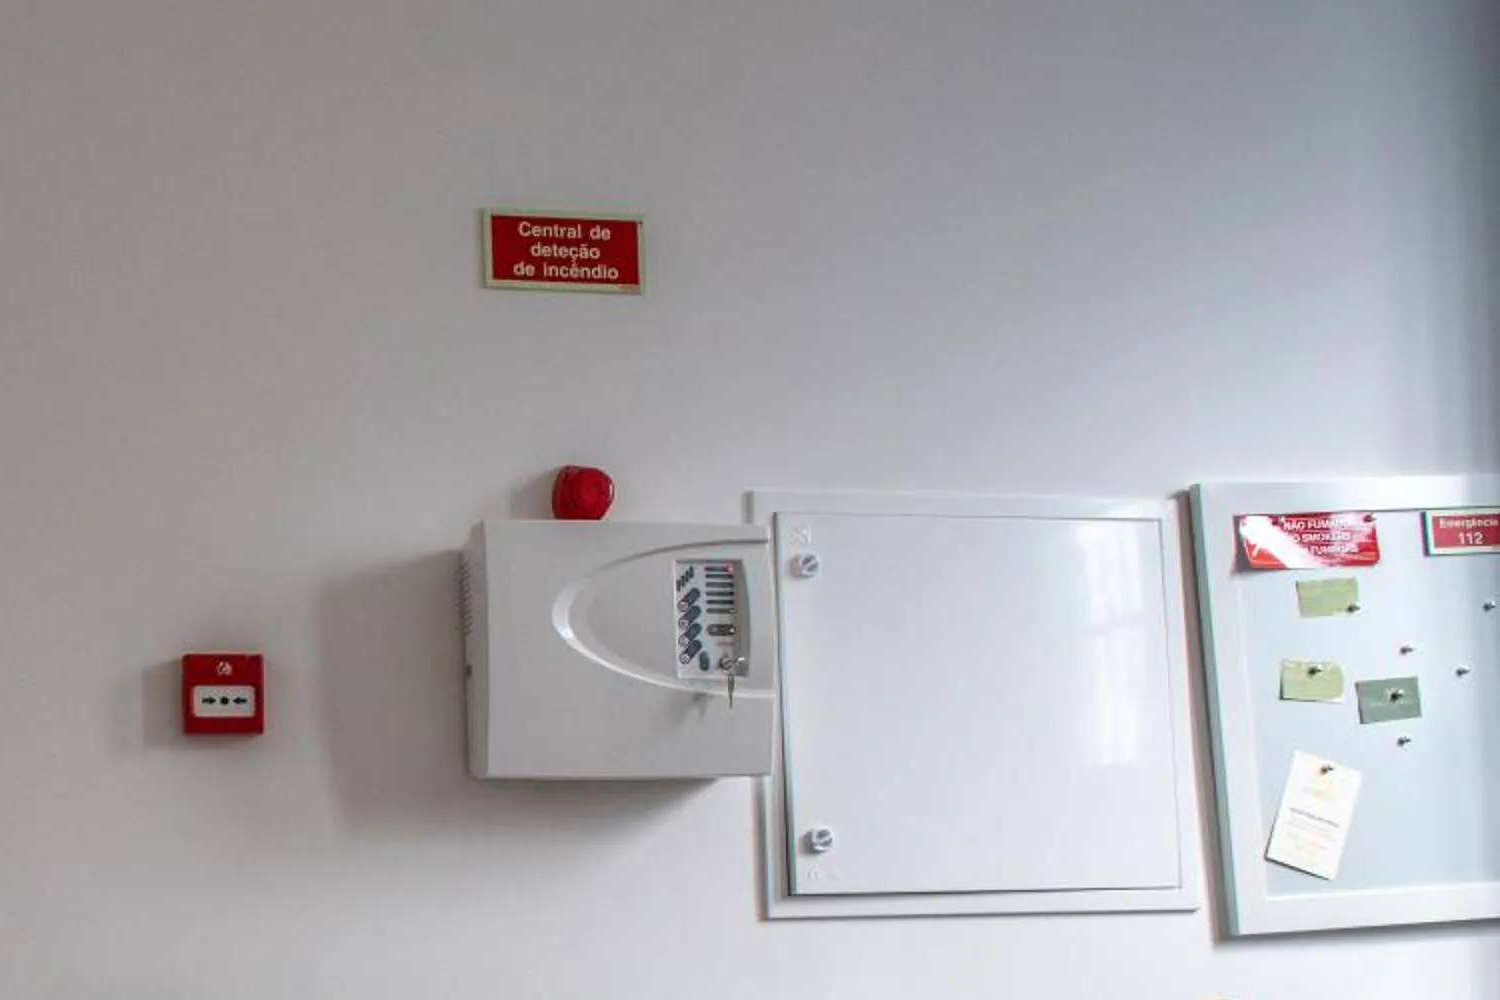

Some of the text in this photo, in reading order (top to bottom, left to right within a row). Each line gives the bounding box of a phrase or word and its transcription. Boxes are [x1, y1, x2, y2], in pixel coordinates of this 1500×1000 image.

[518, 221, 611, 241] Central de
[531, 242, 601, 263] deteção
[513, 261, 619, 280] de incêndio
[1459, 531, 1483, 545] 112
